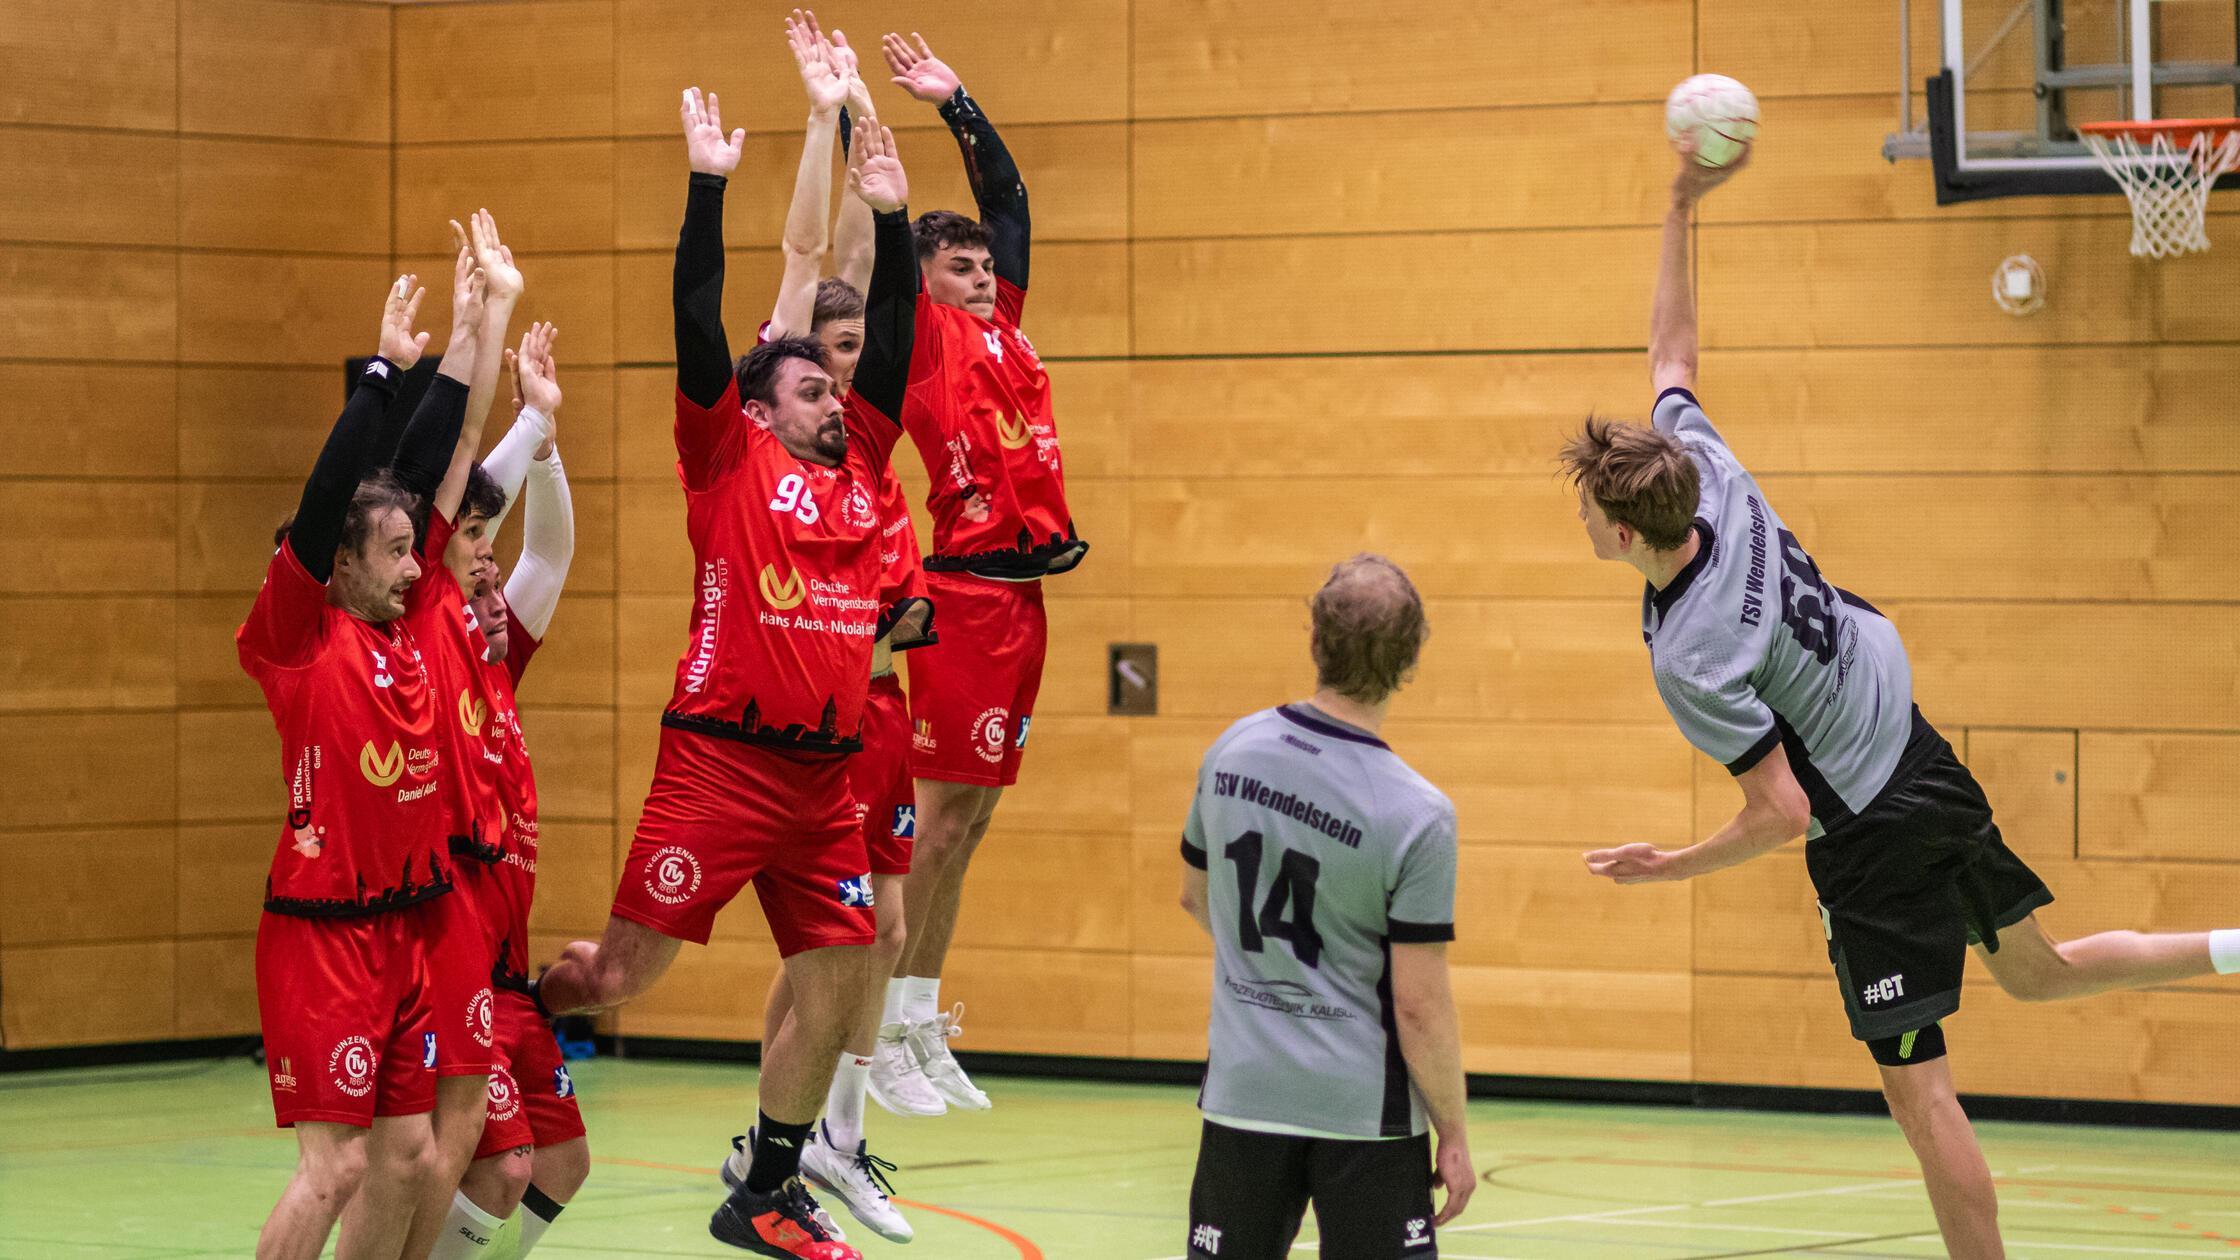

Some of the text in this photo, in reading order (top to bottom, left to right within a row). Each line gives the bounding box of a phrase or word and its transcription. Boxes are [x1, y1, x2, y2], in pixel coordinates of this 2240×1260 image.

[769, 473, 820, 525] 95
[1740, 494, 1767, 627] TSV Wendelstein
[685, 561, 722, 693] Nürminger
[760, 610, 790, 628] Hans
[793, 615, 824, 632] Aust
[831, 620, 865, 639] Nkolaj
[313, 745, 321, 769] GmbH
[397, 780, 438, 803] Daniel Aust
[1214, 771, 1363, 850] TSV Wendelstein
[644, 879, 691, 904] HANDBALL
[657, 882, 678, 894] 1860
[1224, 829, 1324, 970] 14
[1864, 974, 1905, 1005] #CT
[1193, 1223, 1222, 1255] #CT
